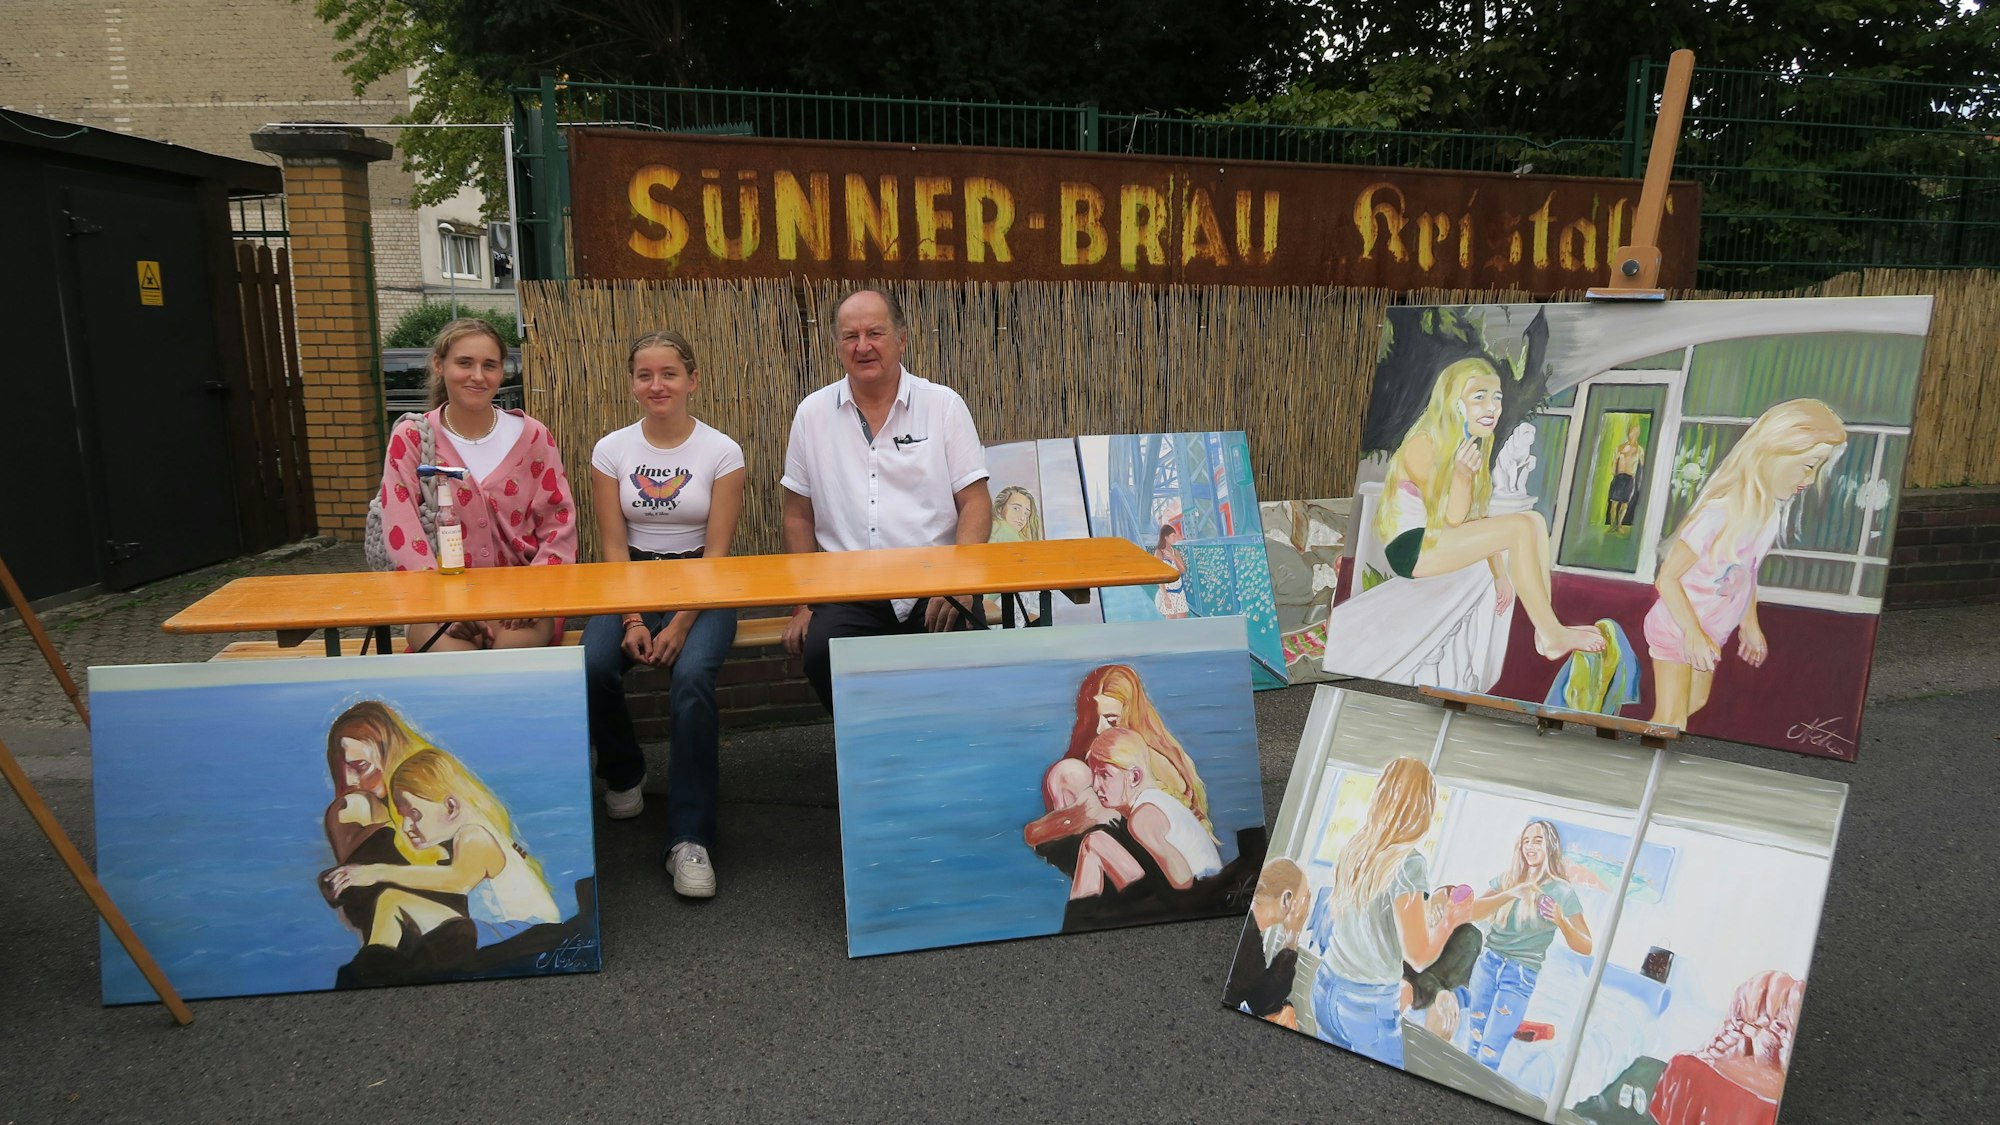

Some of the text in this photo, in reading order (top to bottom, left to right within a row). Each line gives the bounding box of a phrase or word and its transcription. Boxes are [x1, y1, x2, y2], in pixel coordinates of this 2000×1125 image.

[634, 464, 690, 477] time to
[632, 499, 681, 511] enjoy
